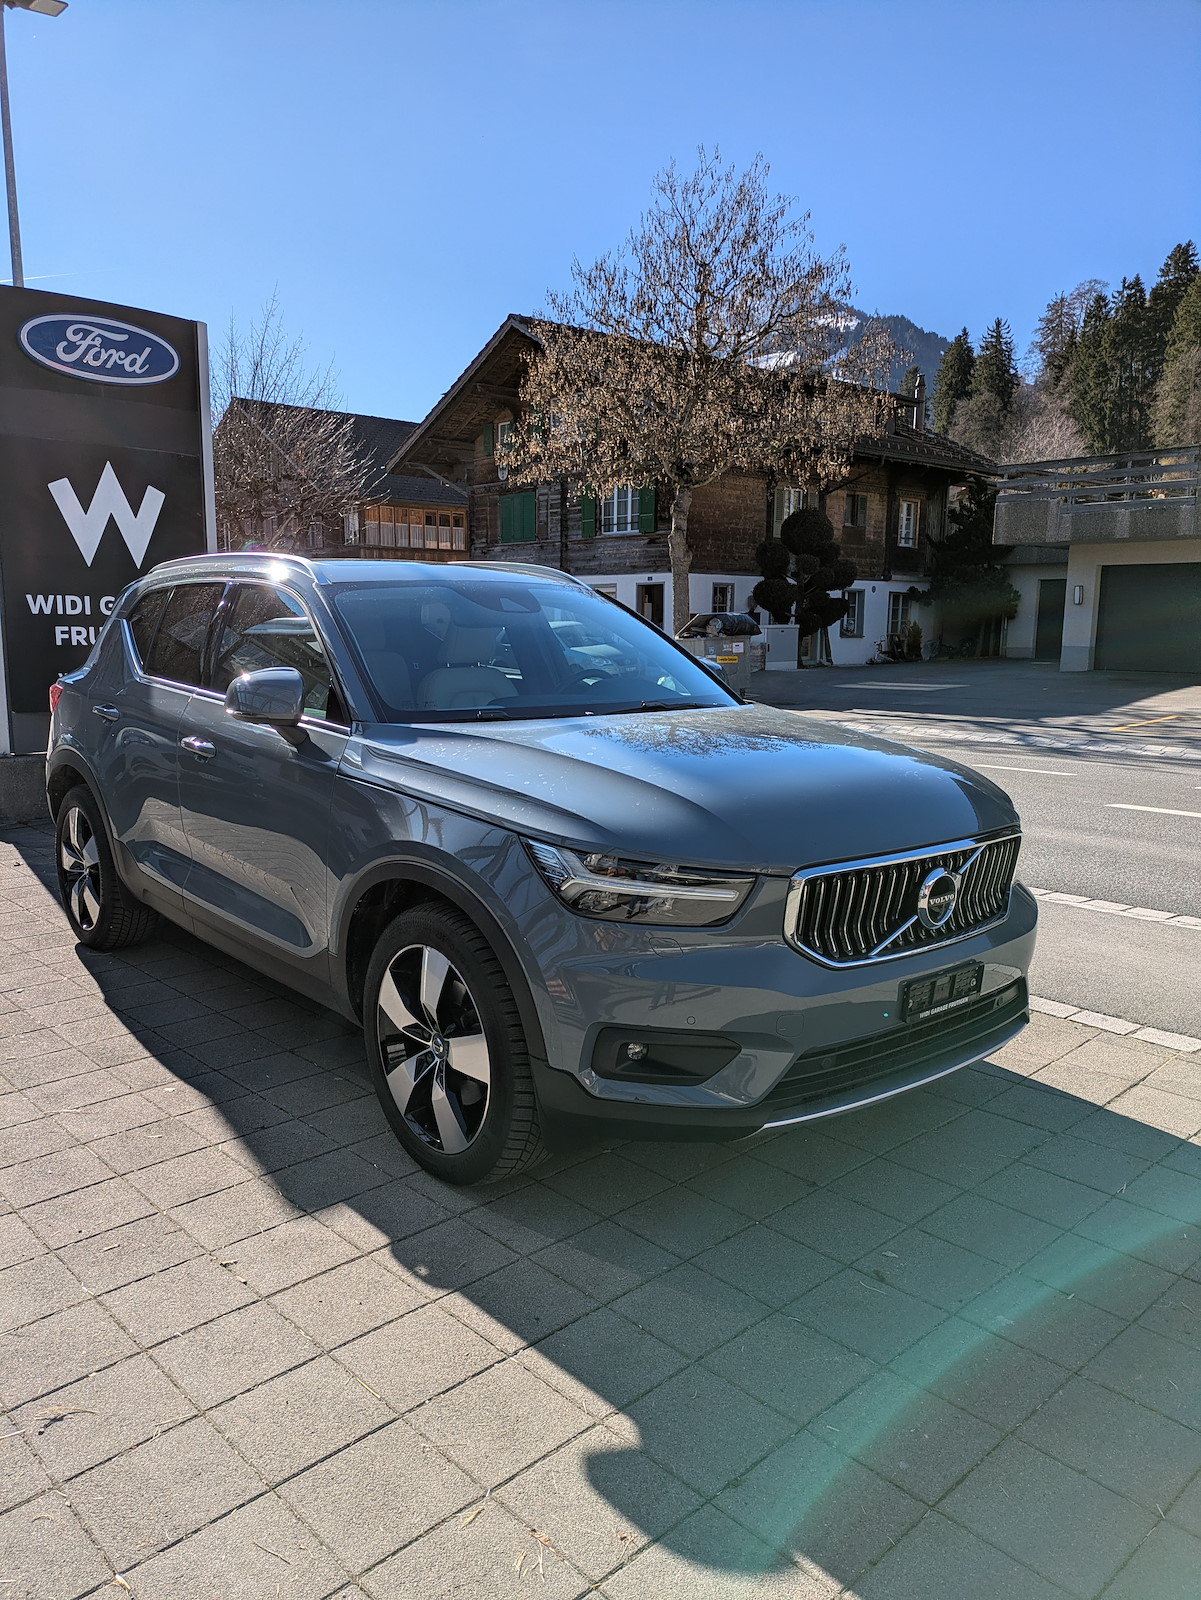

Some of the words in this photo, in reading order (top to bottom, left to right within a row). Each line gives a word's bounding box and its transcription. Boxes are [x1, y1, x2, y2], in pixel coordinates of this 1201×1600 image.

[56, 323, 152, 375] Ford
[48, 461, 166, 569] W
[26, 594, 91, 615] WIDI
[100, 596, 115, 616] G
[55, 626, 103, 646] FRU
[929, 893, 955, 905] VOLVO
